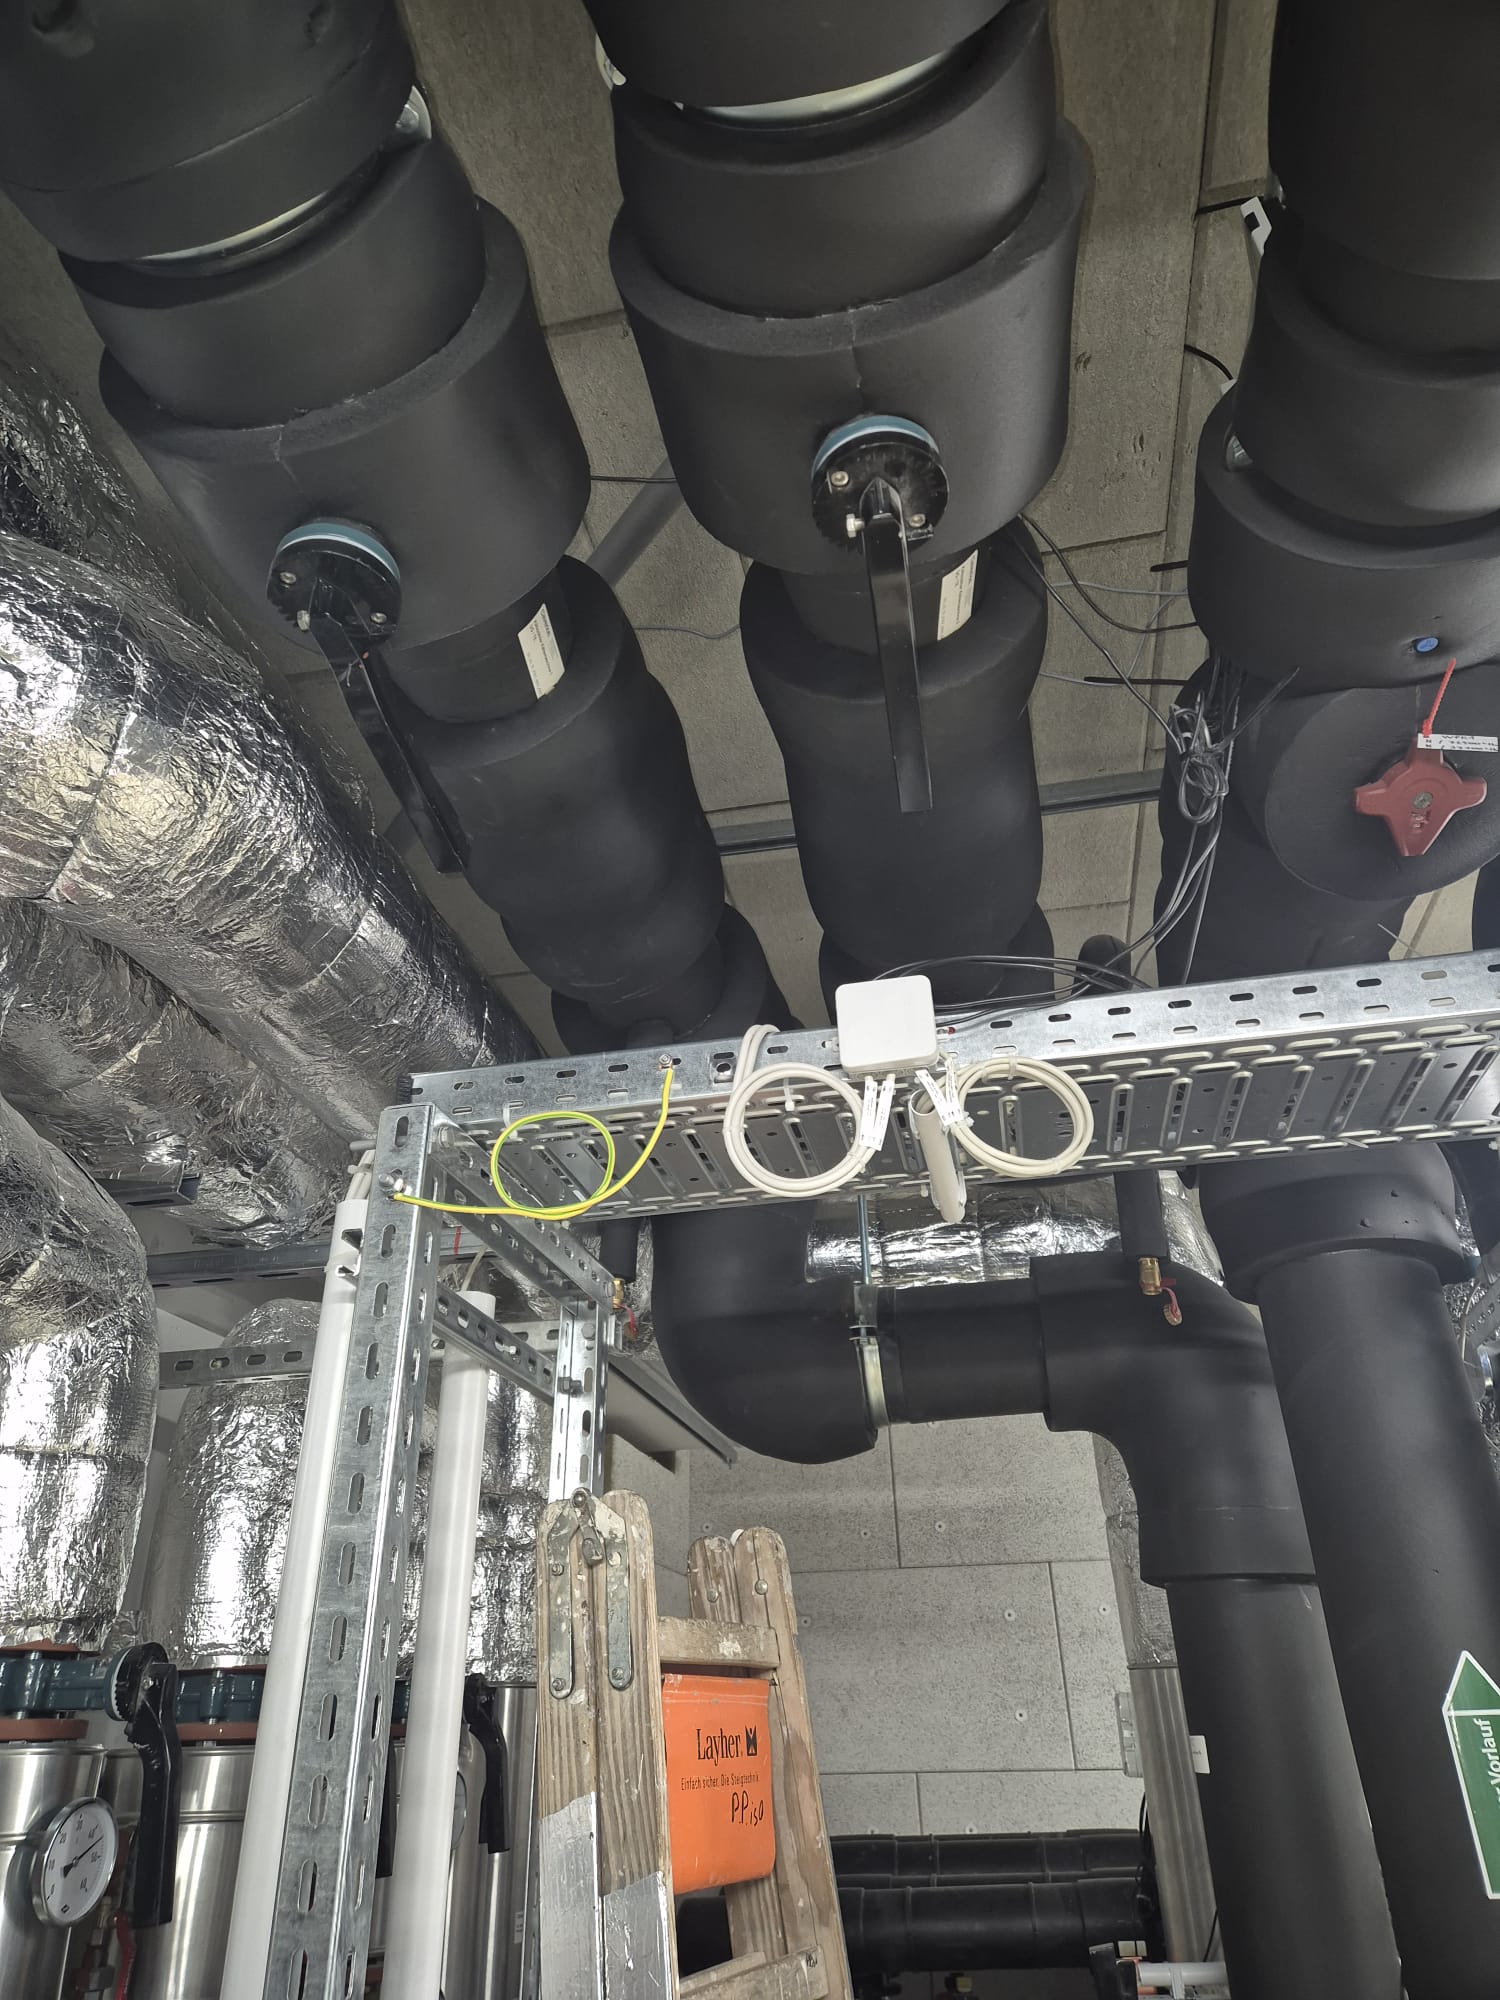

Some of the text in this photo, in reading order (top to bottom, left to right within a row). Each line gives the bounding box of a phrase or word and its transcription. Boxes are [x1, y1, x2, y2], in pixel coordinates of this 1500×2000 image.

[1473, 1717, 1500, 1785] Vorlauf
[681, 1777, 701, 1791] Einfach
[721, 1773, 730, 1786] Die
